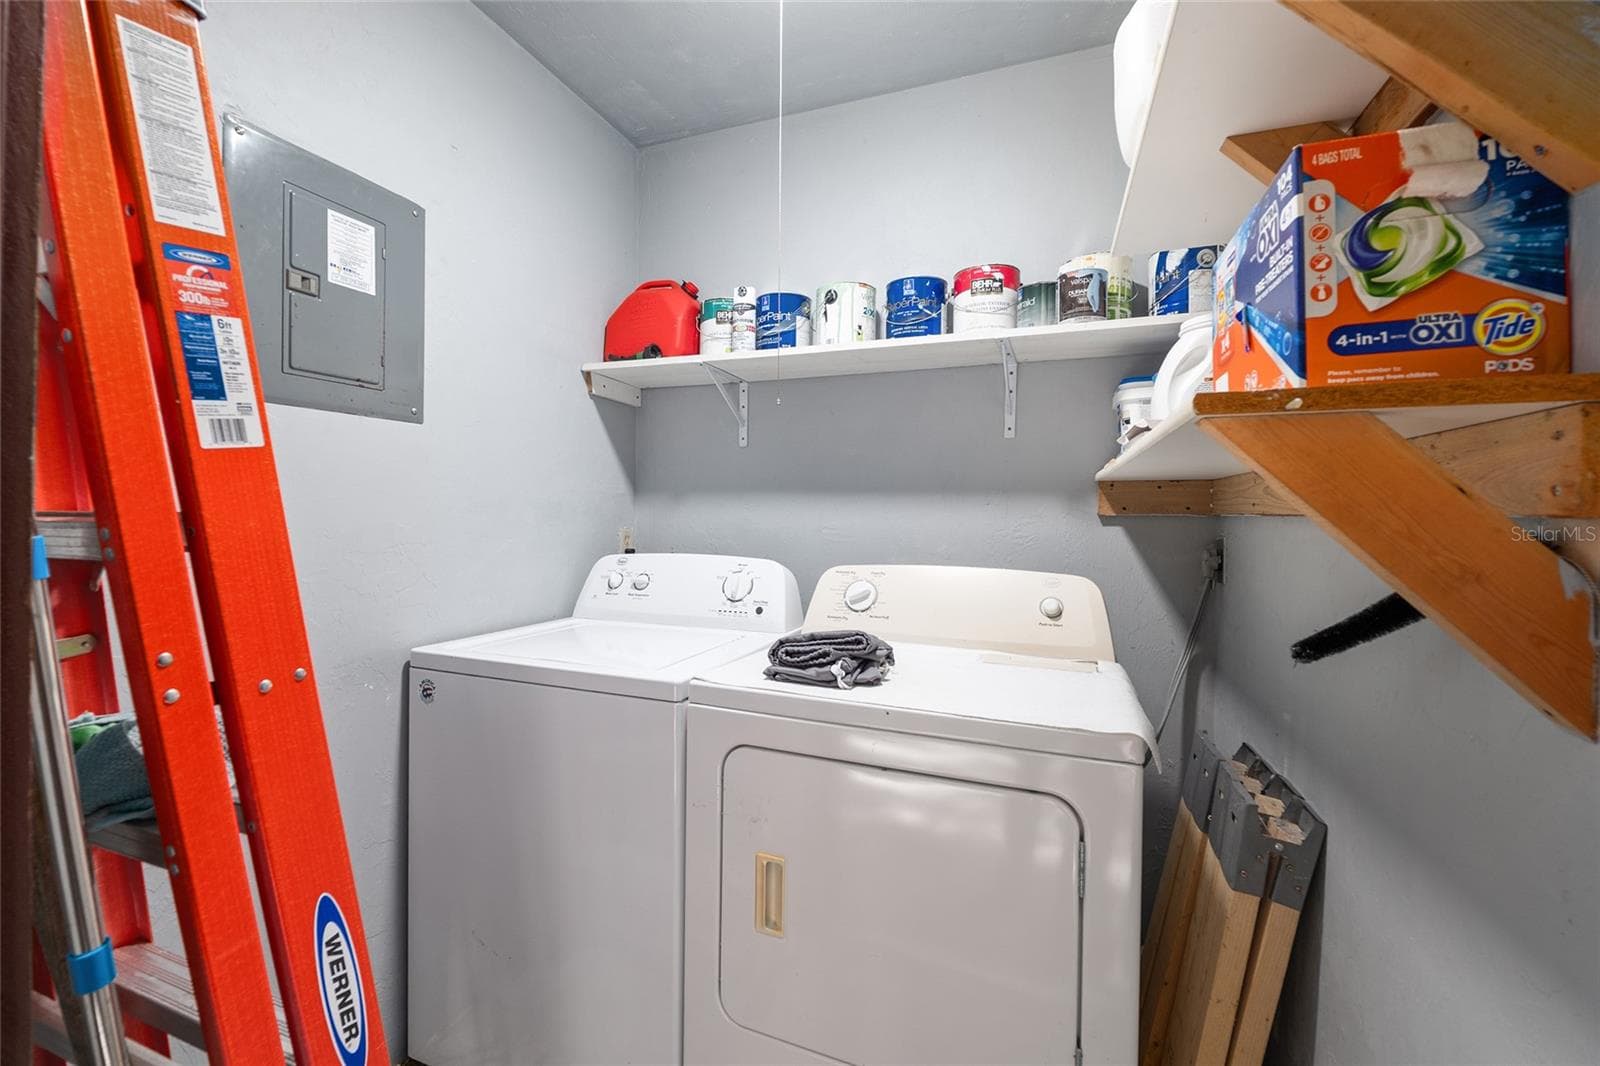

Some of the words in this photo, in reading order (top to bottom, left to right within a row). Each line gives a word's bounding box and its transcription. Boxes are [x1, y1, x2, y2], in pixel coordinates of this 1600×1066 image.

[1312, 153, 1317, 166] 4
[1318, 151, 1338, 165] BAGS
[1339, 147, 1363, 161] TOTAL
[1257, 213, 1279, 263] OXI
[1418, 313, 1461, 324] ULTRA
[1335, 331, 1388, 347] 4-in-1
[1411, 322, 1464, 344] OXI
[1484, 313, 1536, 346] Tide
[1484, 357, 1535, 374] PODS
[325, 932, 360, 1044] WERNER
